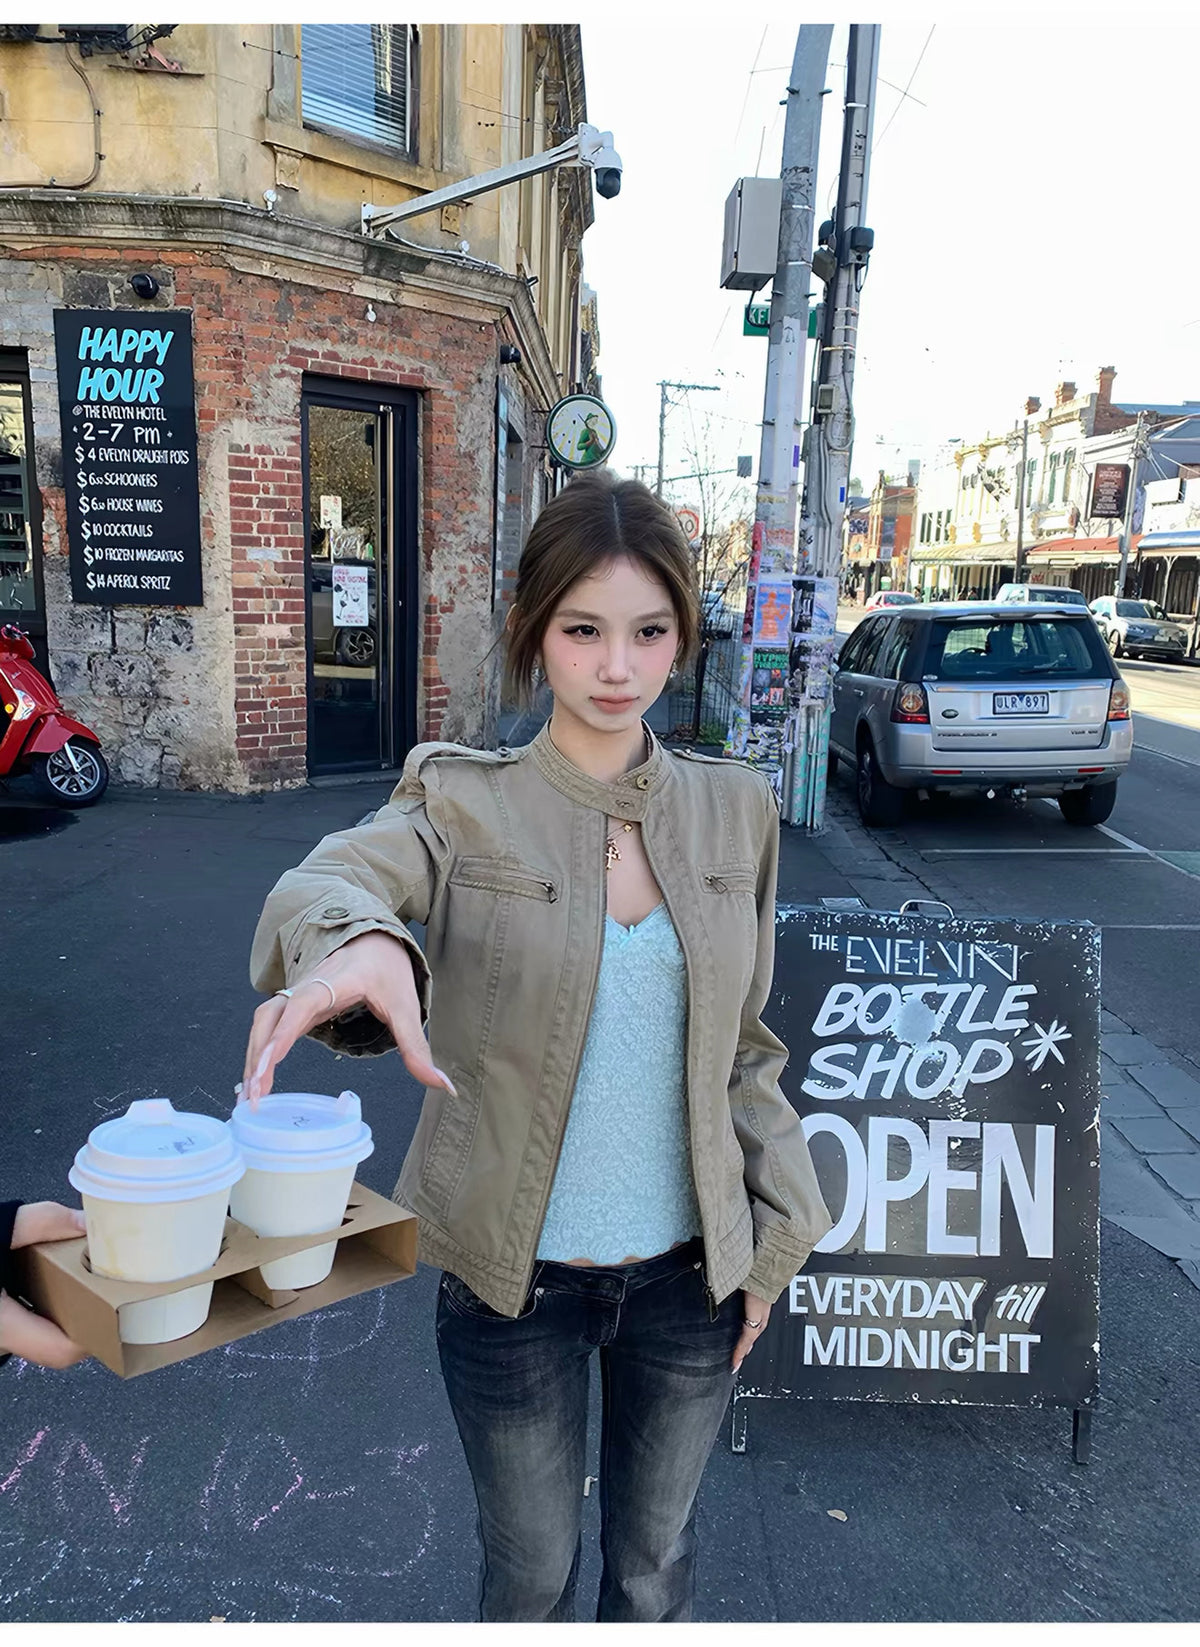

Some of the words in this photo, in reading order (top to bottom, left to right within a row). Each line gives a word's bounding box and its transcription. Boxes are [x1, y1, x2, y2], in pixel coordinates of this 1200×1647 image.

[78, 327, 174, 366] HAPPY
[77, 367, 164, 403] HOUR
[83, 405, 100, 419] THE
[101, 405, 135, 420] EVELYN
[136, 406, 167, 421] HOTEL
[82, 422, 124, 442] 2-7
[98, 447, 131, 462] EVELYN
[132, 448, 169, 464] DRAUGHT
[170, 450, 190, 464] POTS
[104, 472, 158, 487] SCHOONERS
[106, 497, 134, 512] HOUSE
[136, 499, 164, 513] WINES
[103, 523, 154, 537] COCKTAILS
[104, 548, 135, 561] FROZEN
[135, 548, 184, 563] MARGARITAS
[106, 574, 139, 590] APEROL
[140, 574, 171, 590] SPRITZ
[1025, 695, 1046, 708] 897
[809, 934, 839, 951] THE
[846, 935, 1018, 981] EVELYN
[801, 1039, 1014, 1100] SHOP
[800, 1113, 1056, 1259] OPEN
[789, 1275, 986, 1321] EVERYDAY
[995, 1284, 1045, 1324] till
[803, 1325, 1041, 1374] MIDNIGHT
